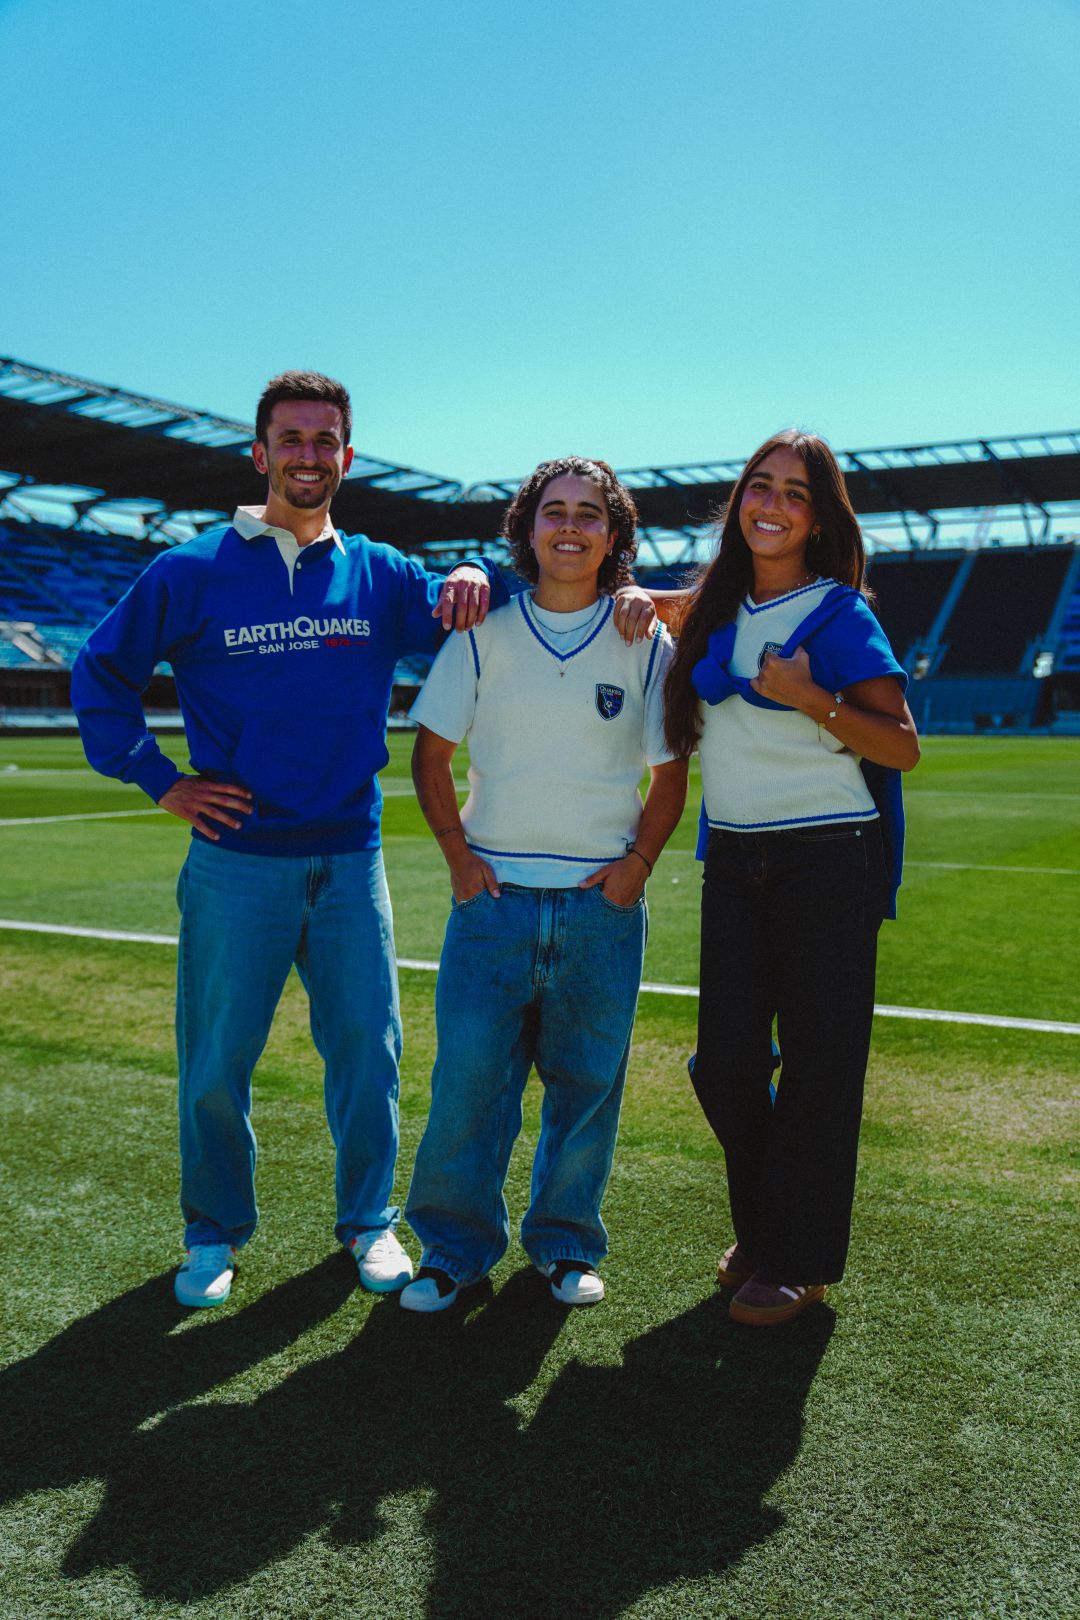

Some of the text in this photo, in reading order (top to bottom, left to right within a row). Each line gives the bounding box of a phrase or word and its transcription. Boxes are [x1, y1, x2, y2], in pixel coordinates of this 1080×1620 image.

[223, 616, 371, 647] EARTHQUAKES
[258, 643, 285, 655] SAN
[288, 640, 320, 652] JOSE
